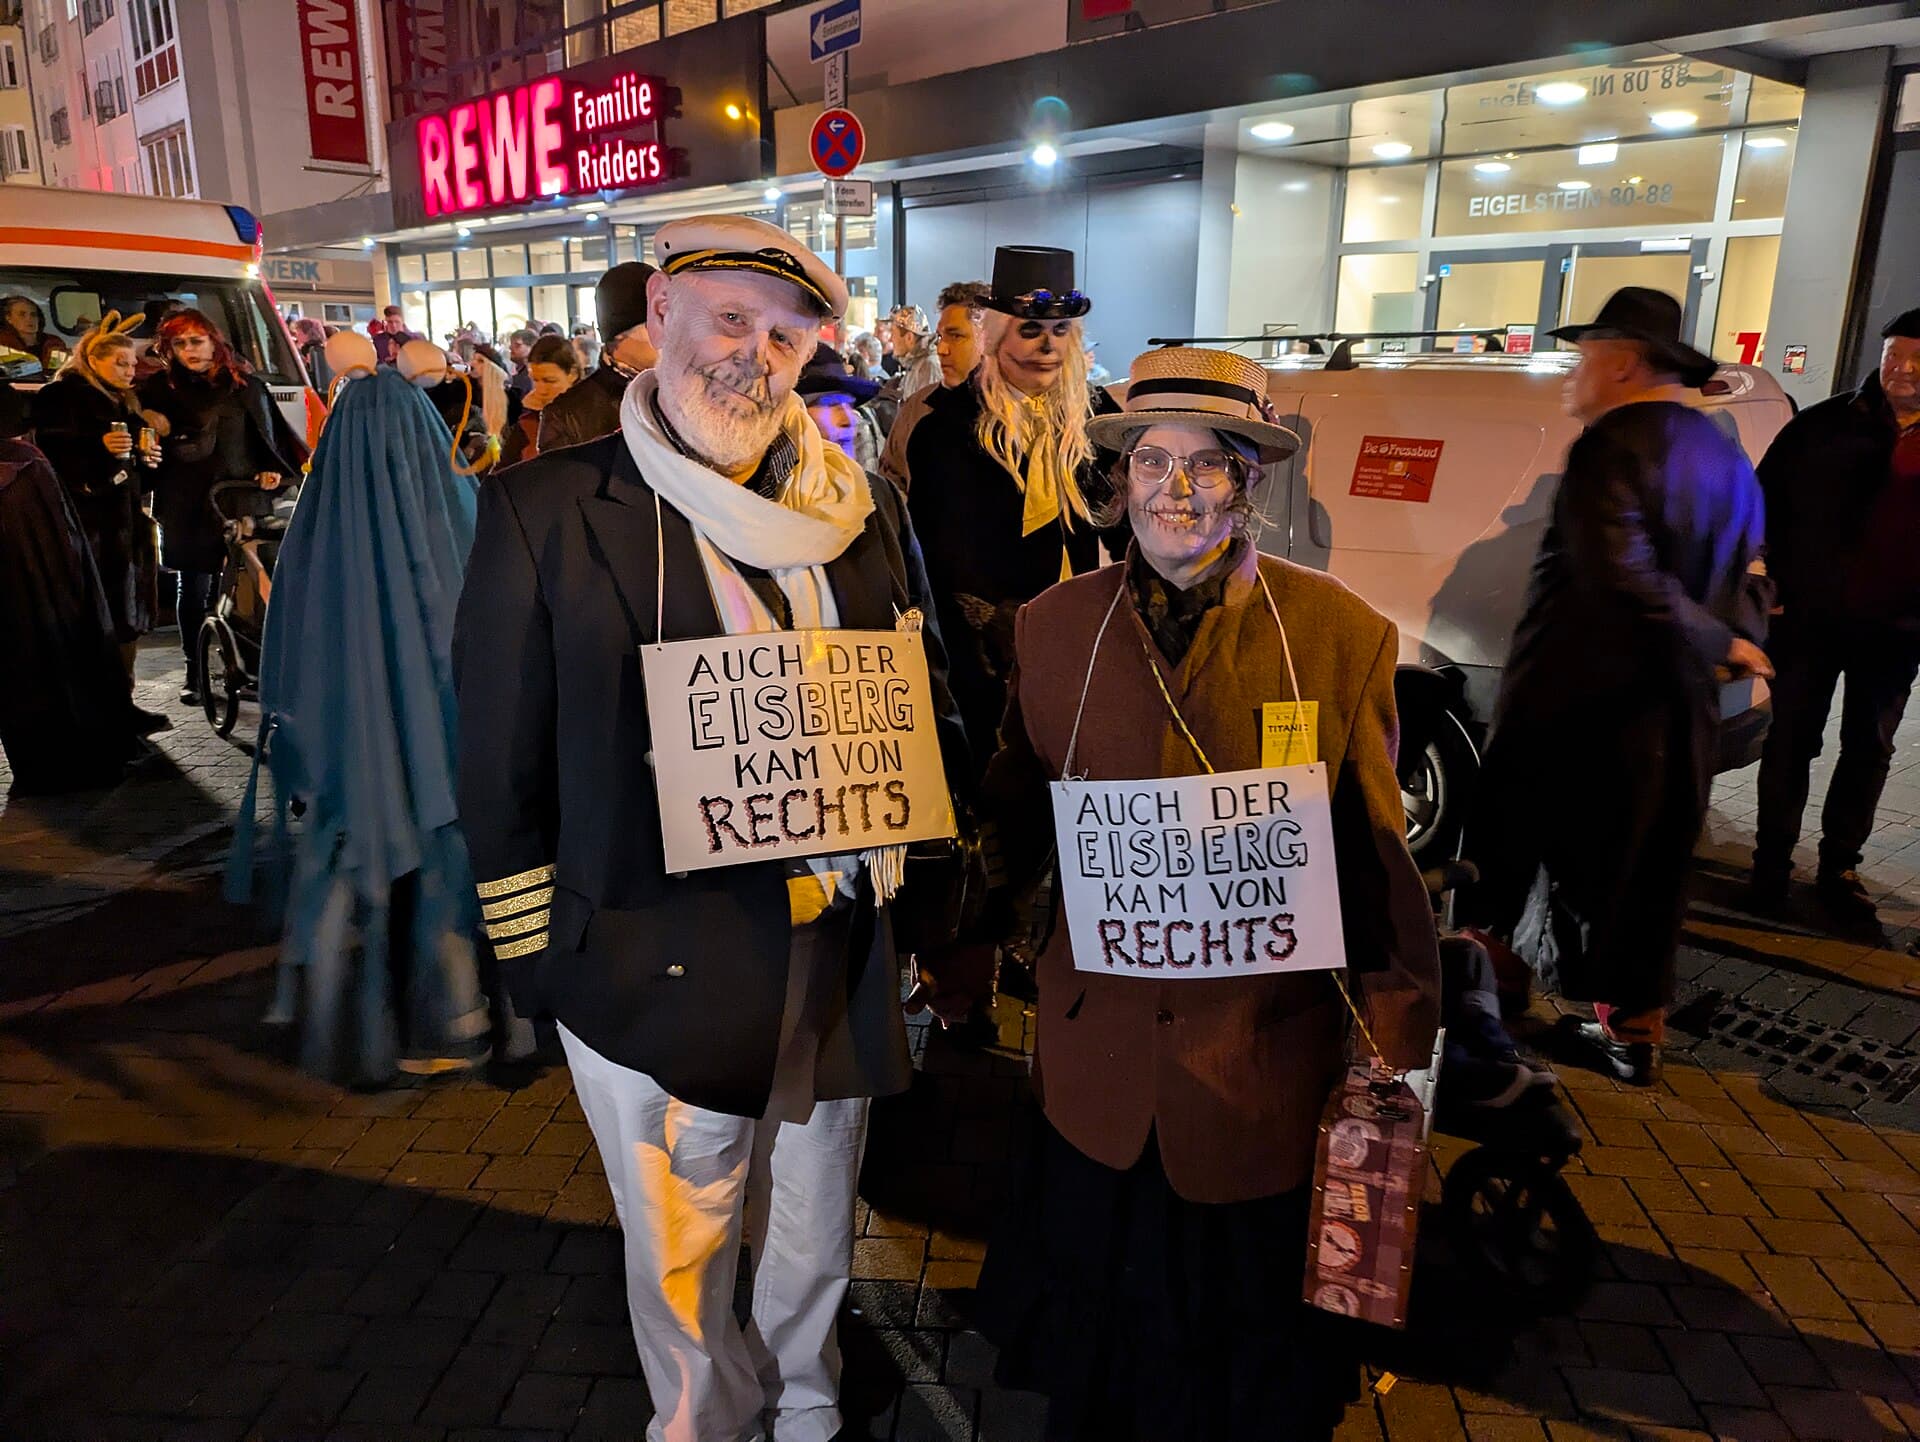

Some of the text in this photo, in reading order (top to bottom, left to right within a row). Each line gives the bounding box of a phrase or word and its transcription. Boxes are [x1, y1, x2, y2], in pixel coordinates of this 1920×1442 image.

[573, 73, 652, 132] Familie
[417, 76, 569, 217] REWE
[577, 140, 661, 189] Ridders
[1469, 184, 1673, 217] EIGELSTEIN 80-88
[1388, 443, 1439, 458] Fressbud
[688, 644, 896, 687] AUCH DER
[688, 678, 914, 751] EISBERG
[735, 739, 903, 788] KAM VON
[698, 780, 911, 855] RECHTS
[1076, 781, 1291, 825] AUCH DER
[1077, 820, 1308, 878] EISBERG
[1104, 876, 1286, 913] KAM VON
[1097, 913, 1298, 968] RECHTS
